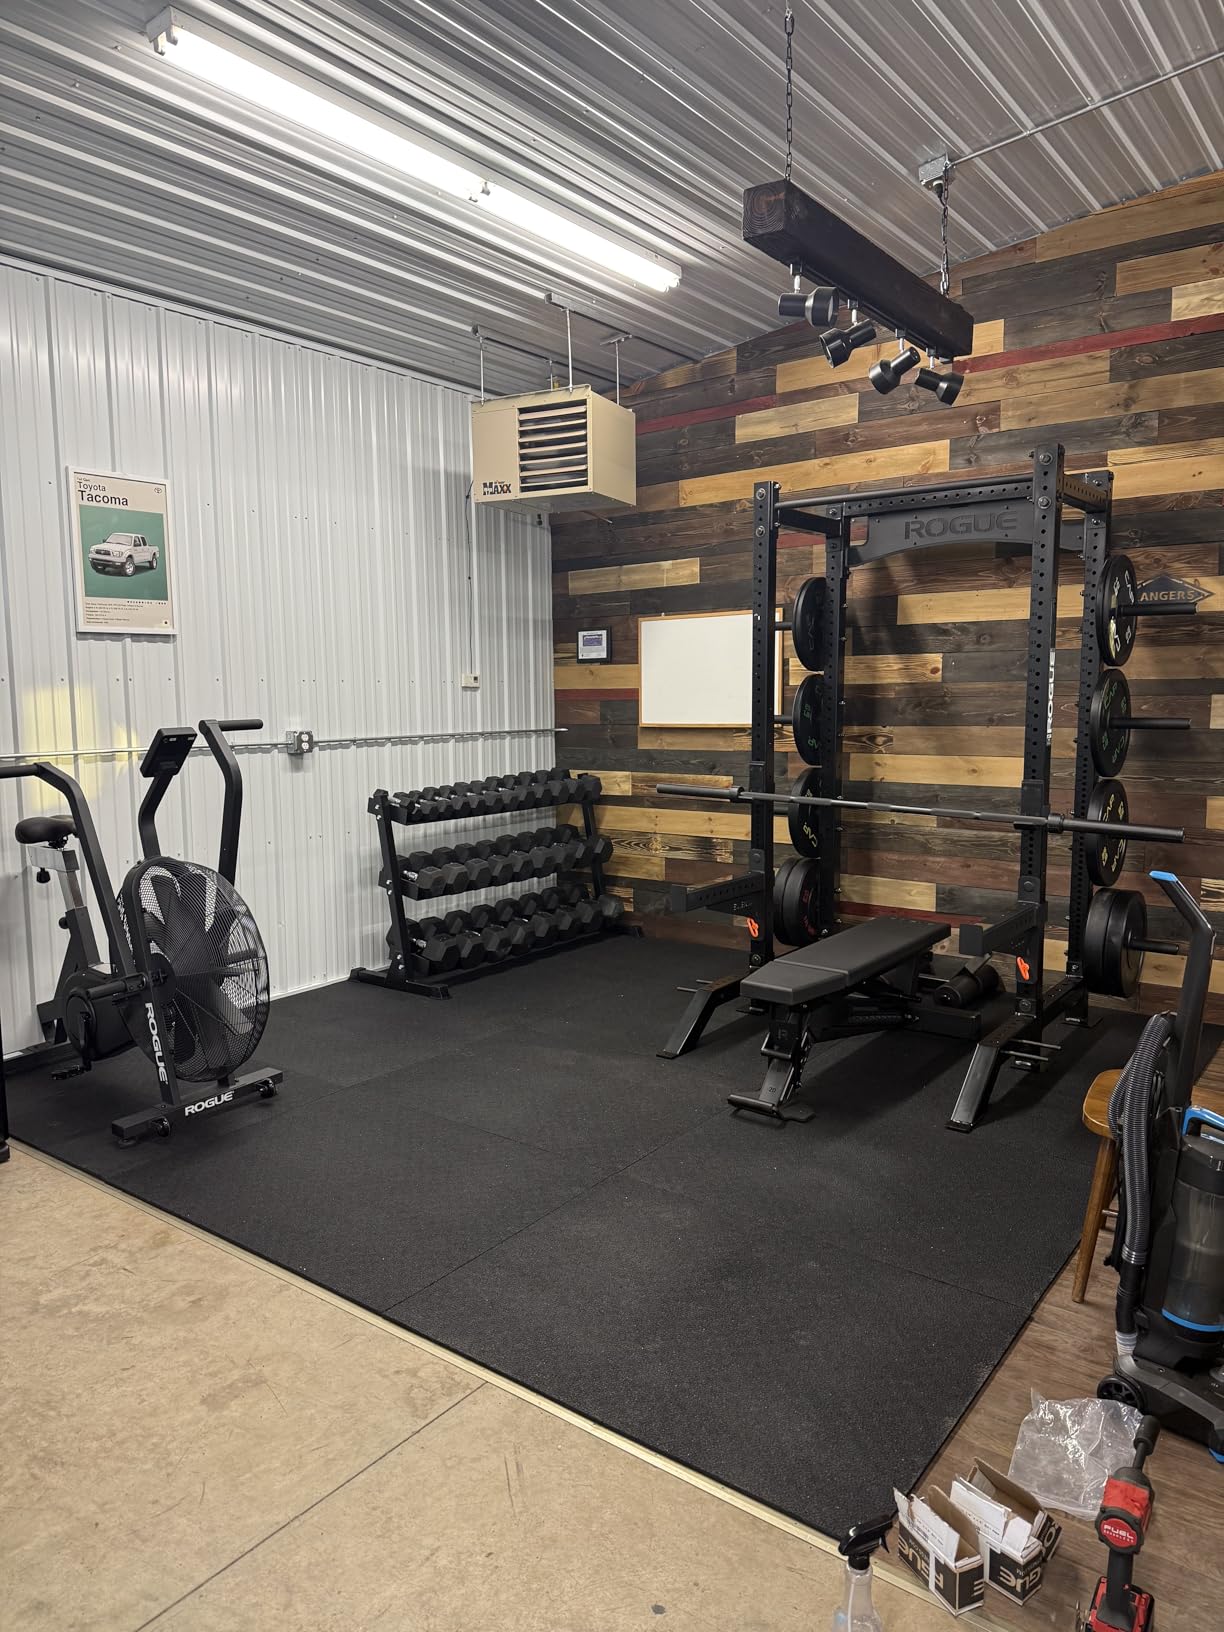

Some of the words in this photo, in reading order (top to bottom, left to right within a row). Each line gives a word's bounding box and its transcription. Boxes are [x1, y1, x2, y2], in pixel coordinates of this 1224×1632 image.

[77, 481, 106, 492] Toyota
[78, 490, 128, 506] Tacoma
[904, 510, 1018, 540] ROGUE
[1140, 590, 1195, 602] ANGERS
[1046, 649, 1056, 734] ROGUE
[145, 1002, 168, 1083] ROGUE
[184, 1090, 235, 1116] ROGUE
[1103, 1524, 1134, 1540] FUEL
